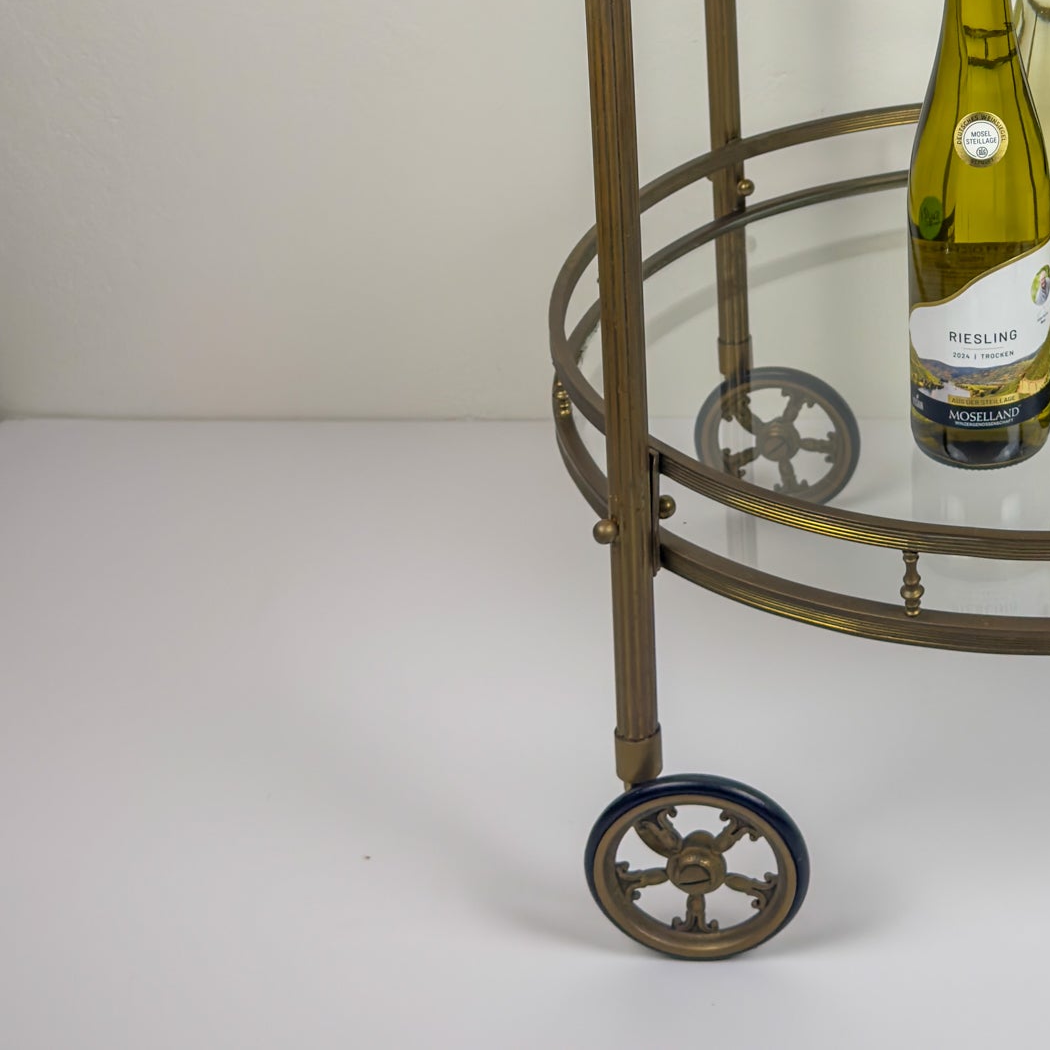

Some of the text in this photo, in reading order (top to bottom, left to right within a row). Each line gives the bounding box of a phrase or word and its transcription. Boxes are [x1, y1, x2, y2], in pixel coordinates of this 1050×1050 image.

[966, 137, 997, 145] STEILLAGE
[949, 329, 1018, 345] RIESLING
[953, 349, 1015, 359] 2024 TROCKEN
[949, 406, 1020, 422] MOSELLAND
